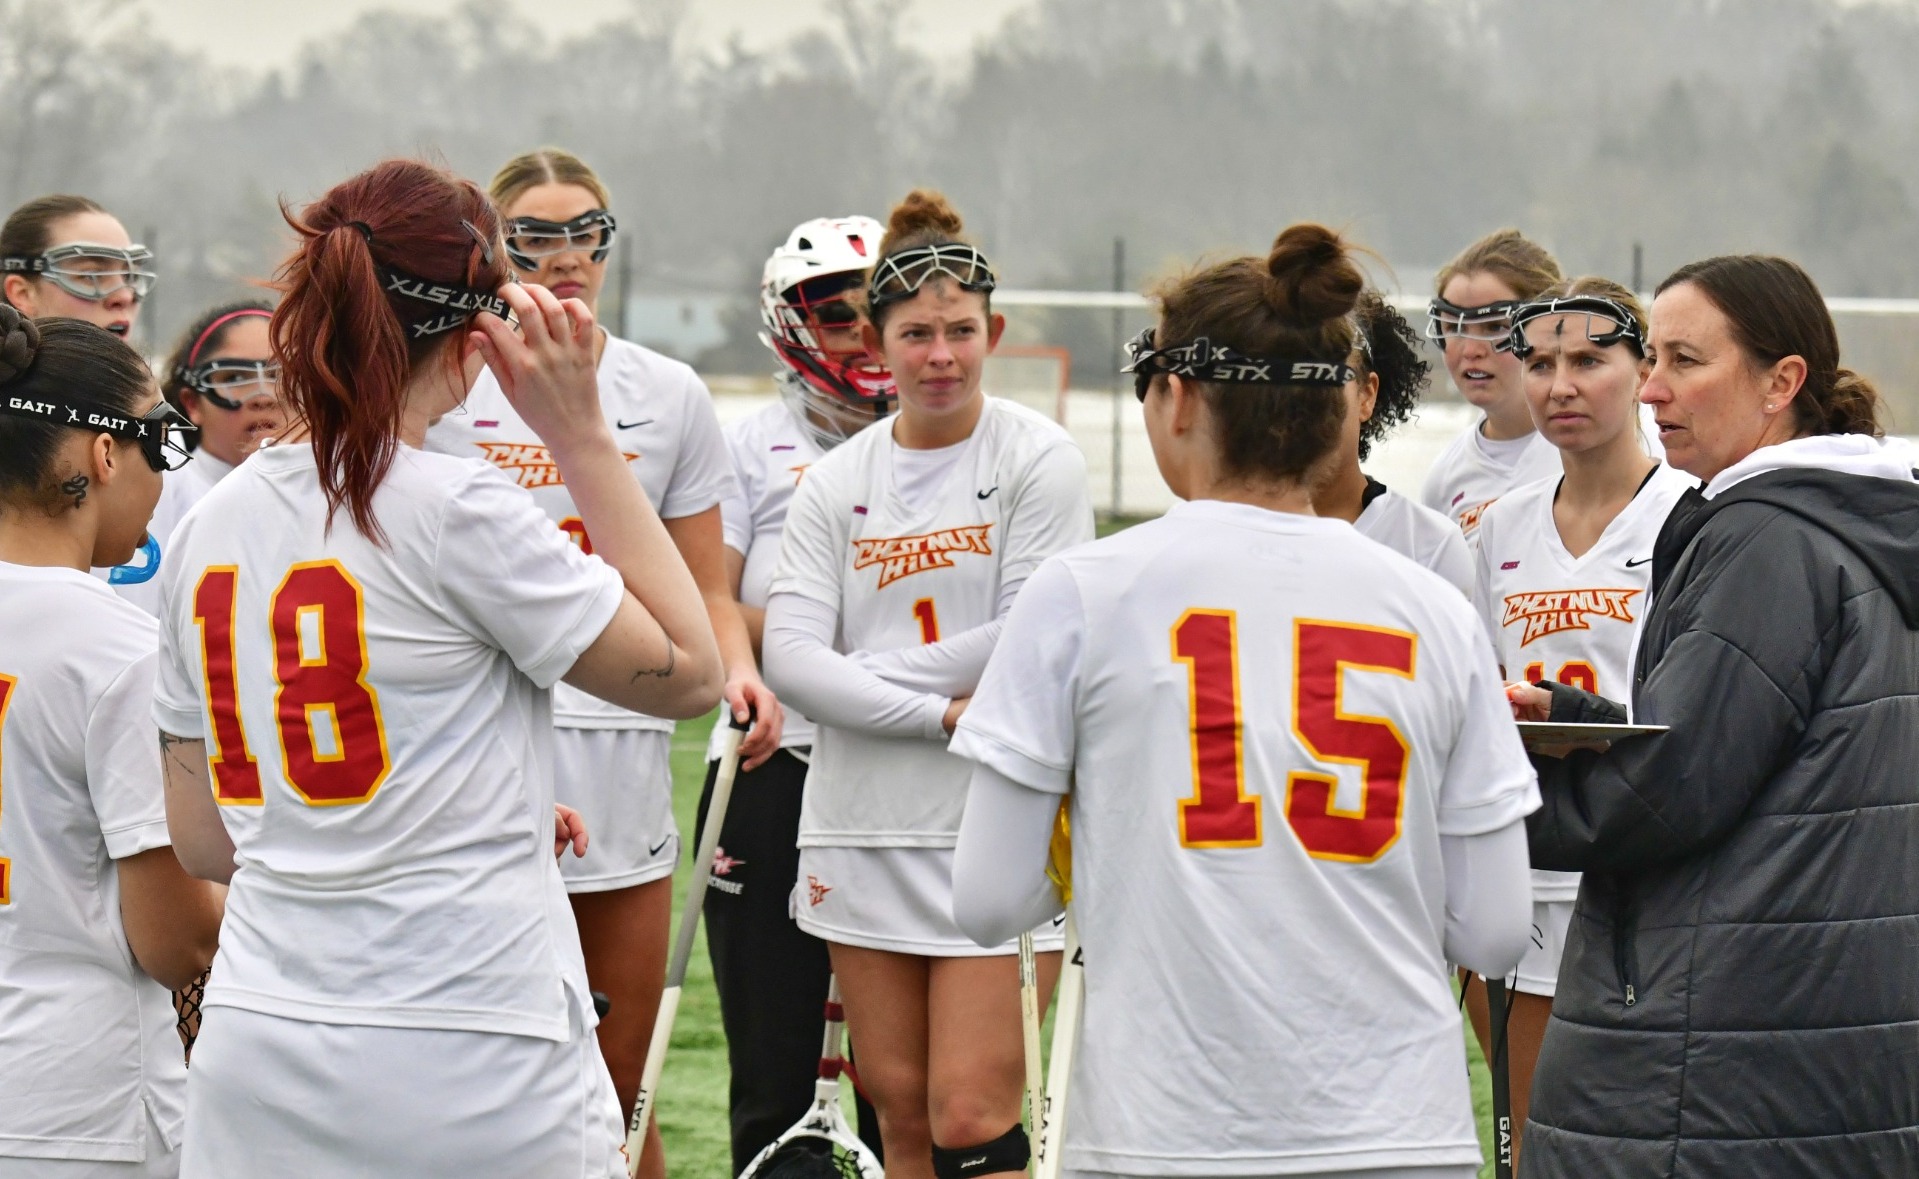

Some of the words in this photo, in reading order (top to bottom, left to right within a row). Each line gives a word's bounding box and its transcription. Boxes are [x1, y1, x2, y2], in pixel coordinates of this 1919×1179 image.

[1212, 363, 1272, 382] STX
[1289, 362, 1340, 381] STX
[9, 397, 56, 416] GAIT
[87, 413, 128, 431] GAIT
[852, 523, 995, 570] CHESTNUT
[912, 597, 941, 646] 1
[1502, 588, 1645, 628] CHESTNUT
[193, 558, 392, 807] 18
[1169, 607, 1418, 864] 15
[1499, 1116, 1512, 1167] GAIT
